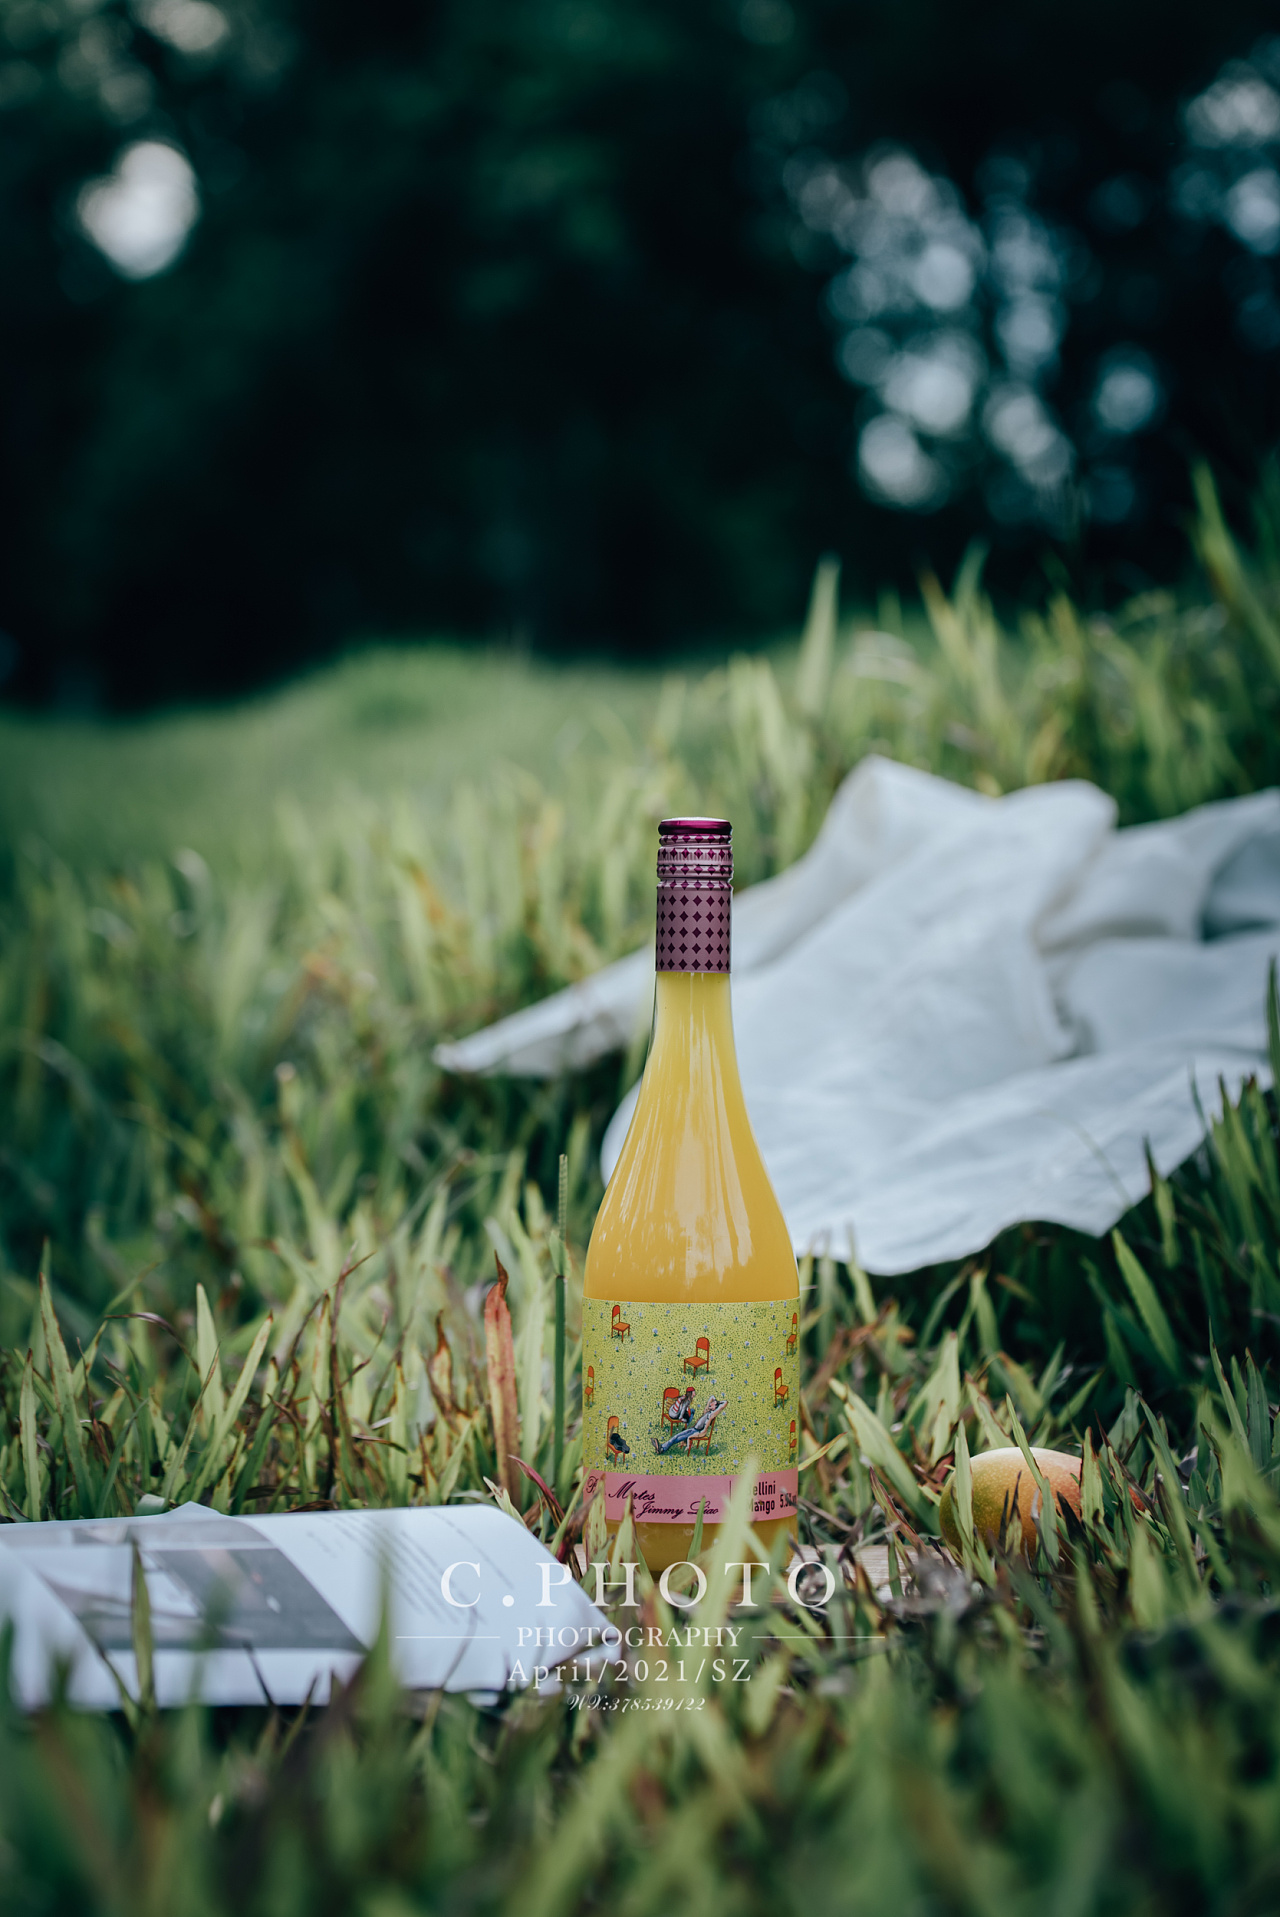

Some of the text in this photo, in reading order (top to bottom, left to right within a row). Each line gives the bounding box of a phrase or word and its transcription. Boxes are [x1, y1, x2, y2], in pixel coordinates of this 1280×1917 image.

[751, 1480, 776, 1496] ellini
[636, 1501, 684, 1519] Jimmy
[687, 1501, 719, 1515] Liao
